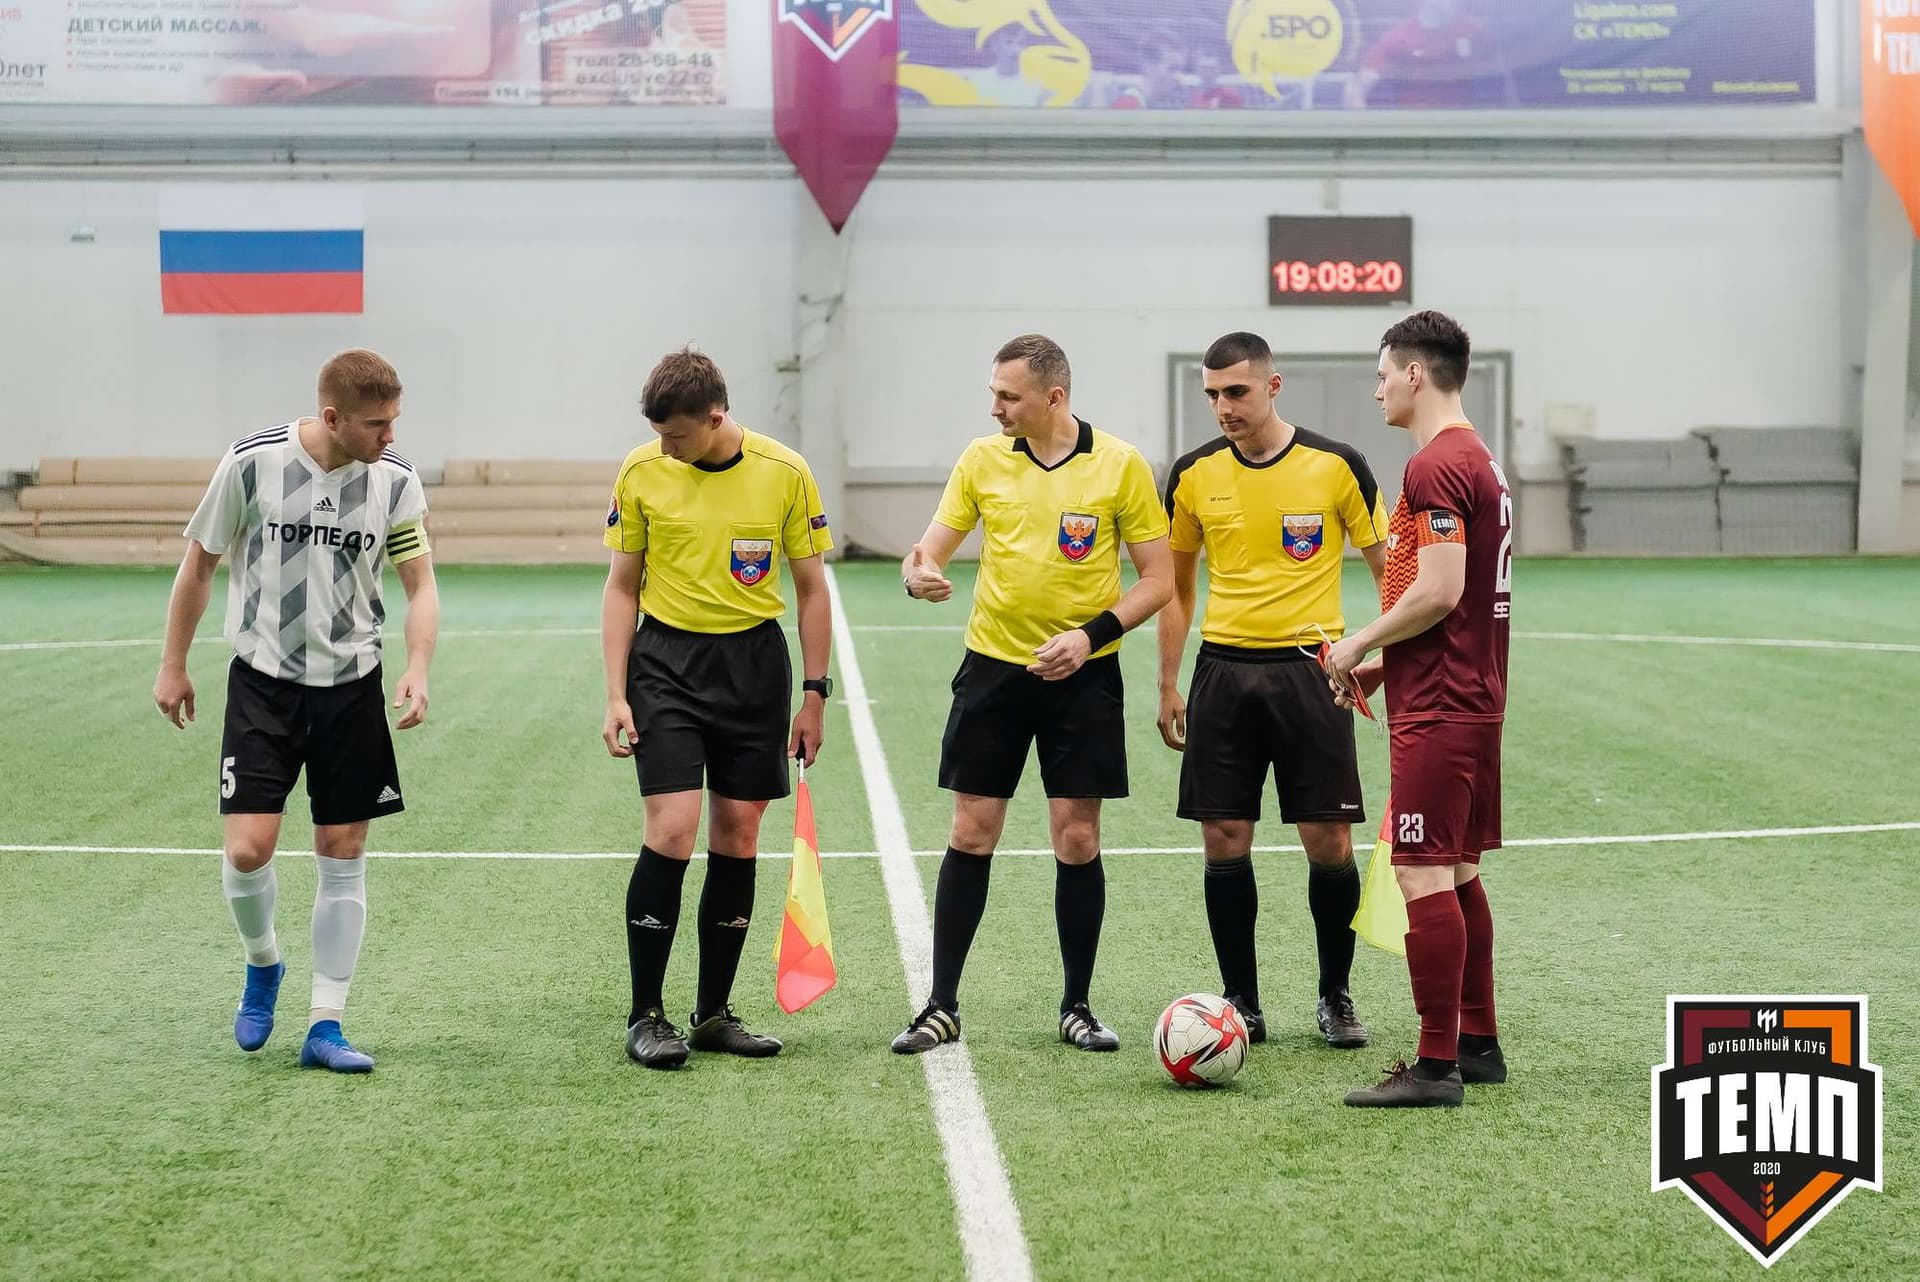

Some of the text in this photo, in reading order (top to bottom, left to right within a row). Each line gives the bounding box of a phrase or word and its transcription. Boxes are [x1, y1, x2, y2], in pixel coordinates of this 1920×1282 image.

[67, 17, 162, 34] ДЕТСКИЙ
[1273, 260, 1403, 293] 19:08:20
[268, 522, 376, 554] ТОРПЕДО
[1432, 518, 1456, 529] ТЕМП
[221, 756, 237, 800] 5
[1399, 813, 1424, 843] 23
